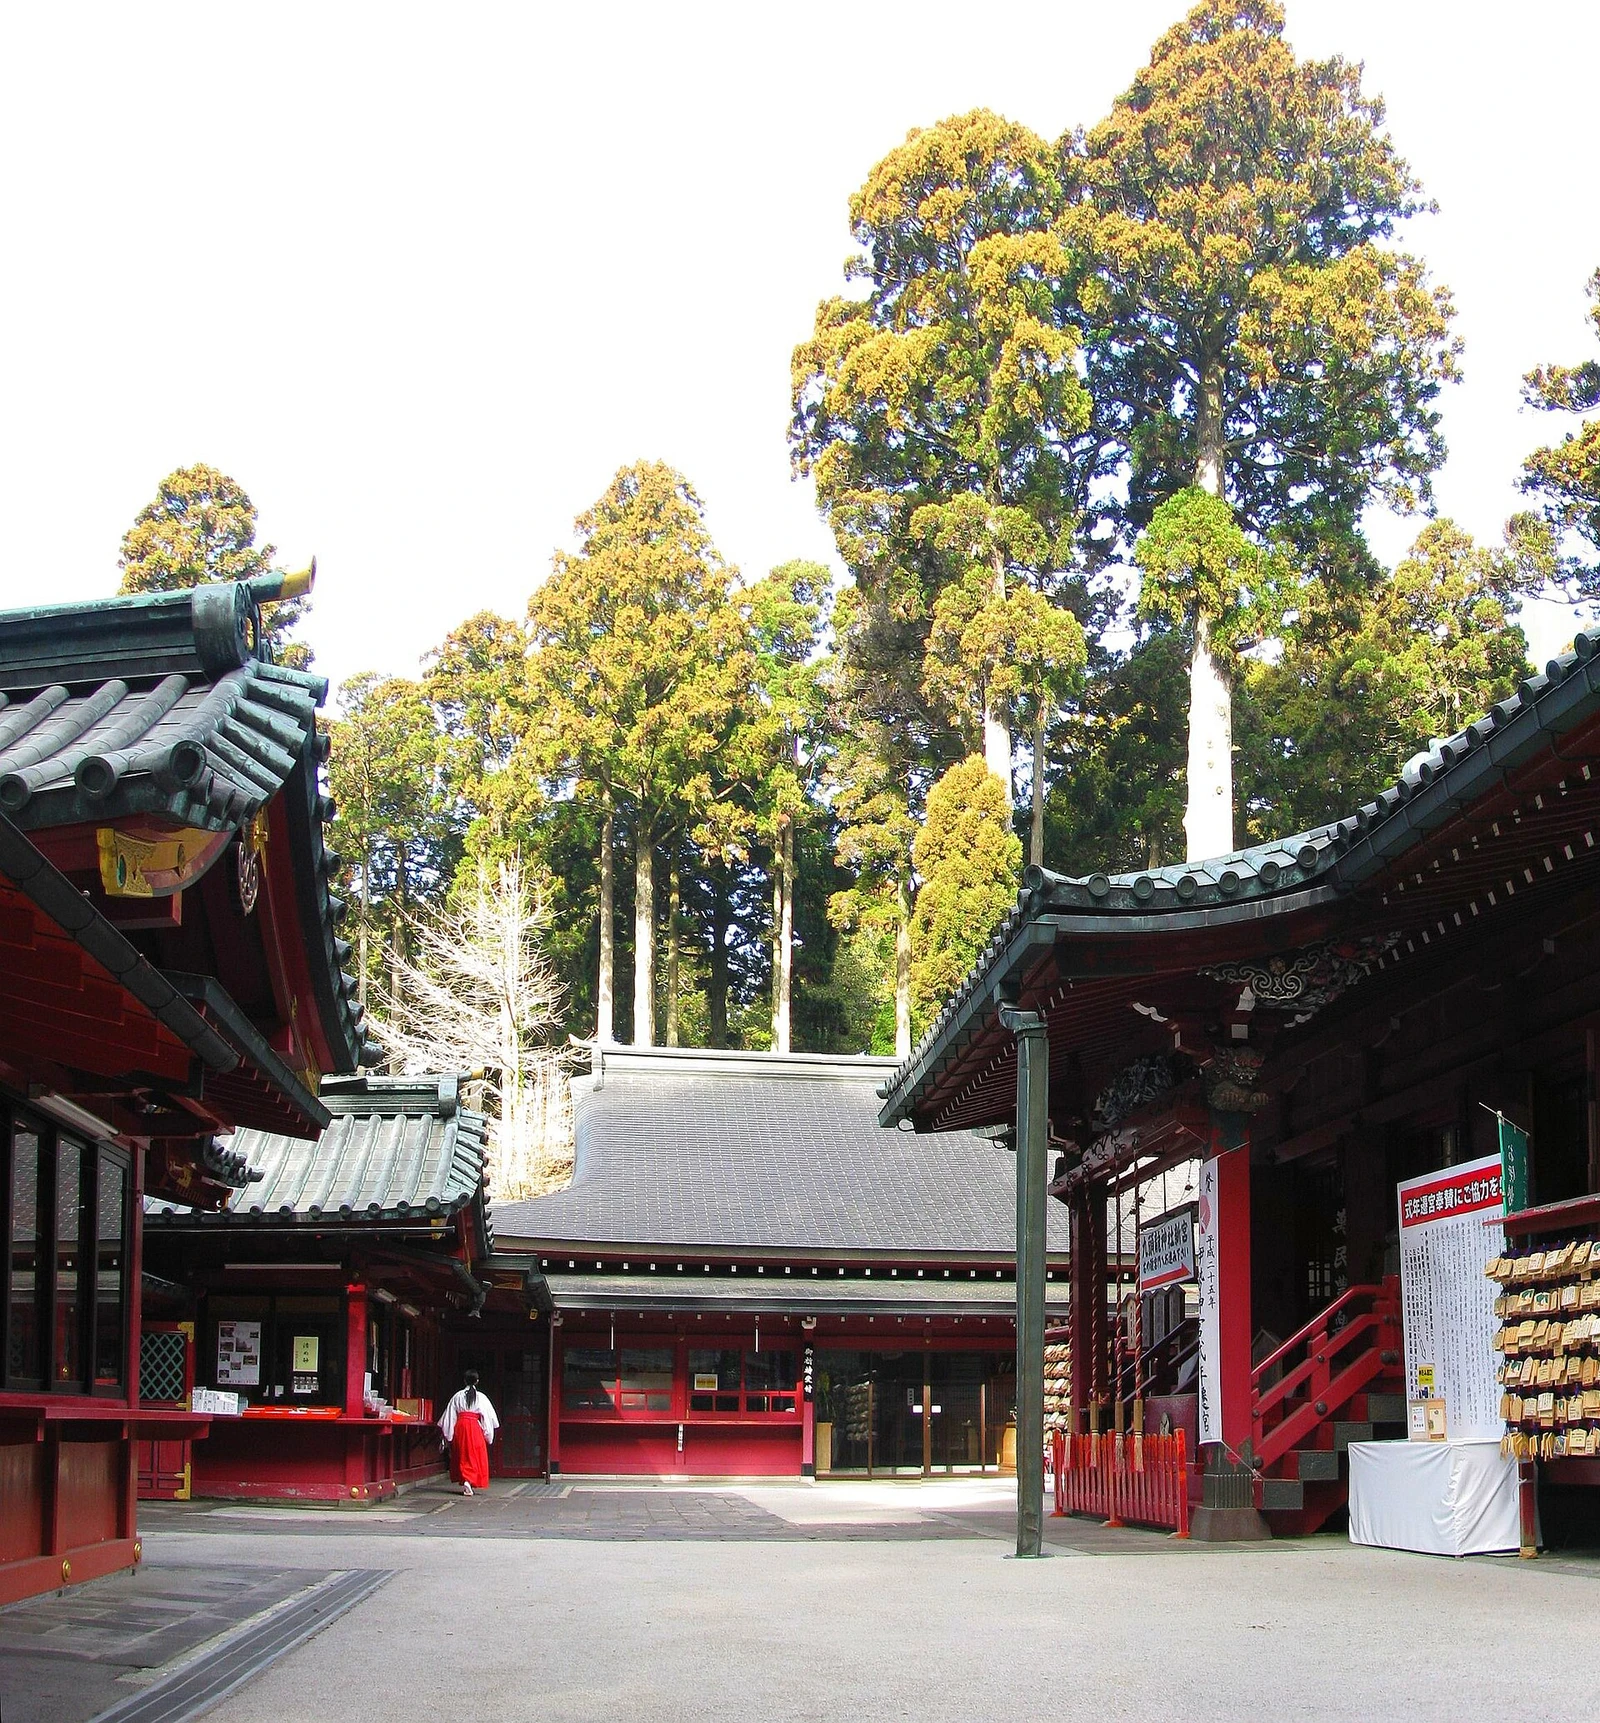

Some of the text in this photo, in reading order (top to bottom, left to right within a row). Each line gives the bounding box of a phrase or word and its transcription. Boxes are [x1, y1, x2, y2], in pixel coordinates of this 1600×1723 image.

[1404, 1176, 1505, 1219] 式年遷宮奉賛にご協力を
[1206, 1234, 1216, 1310] 平成二十五年
